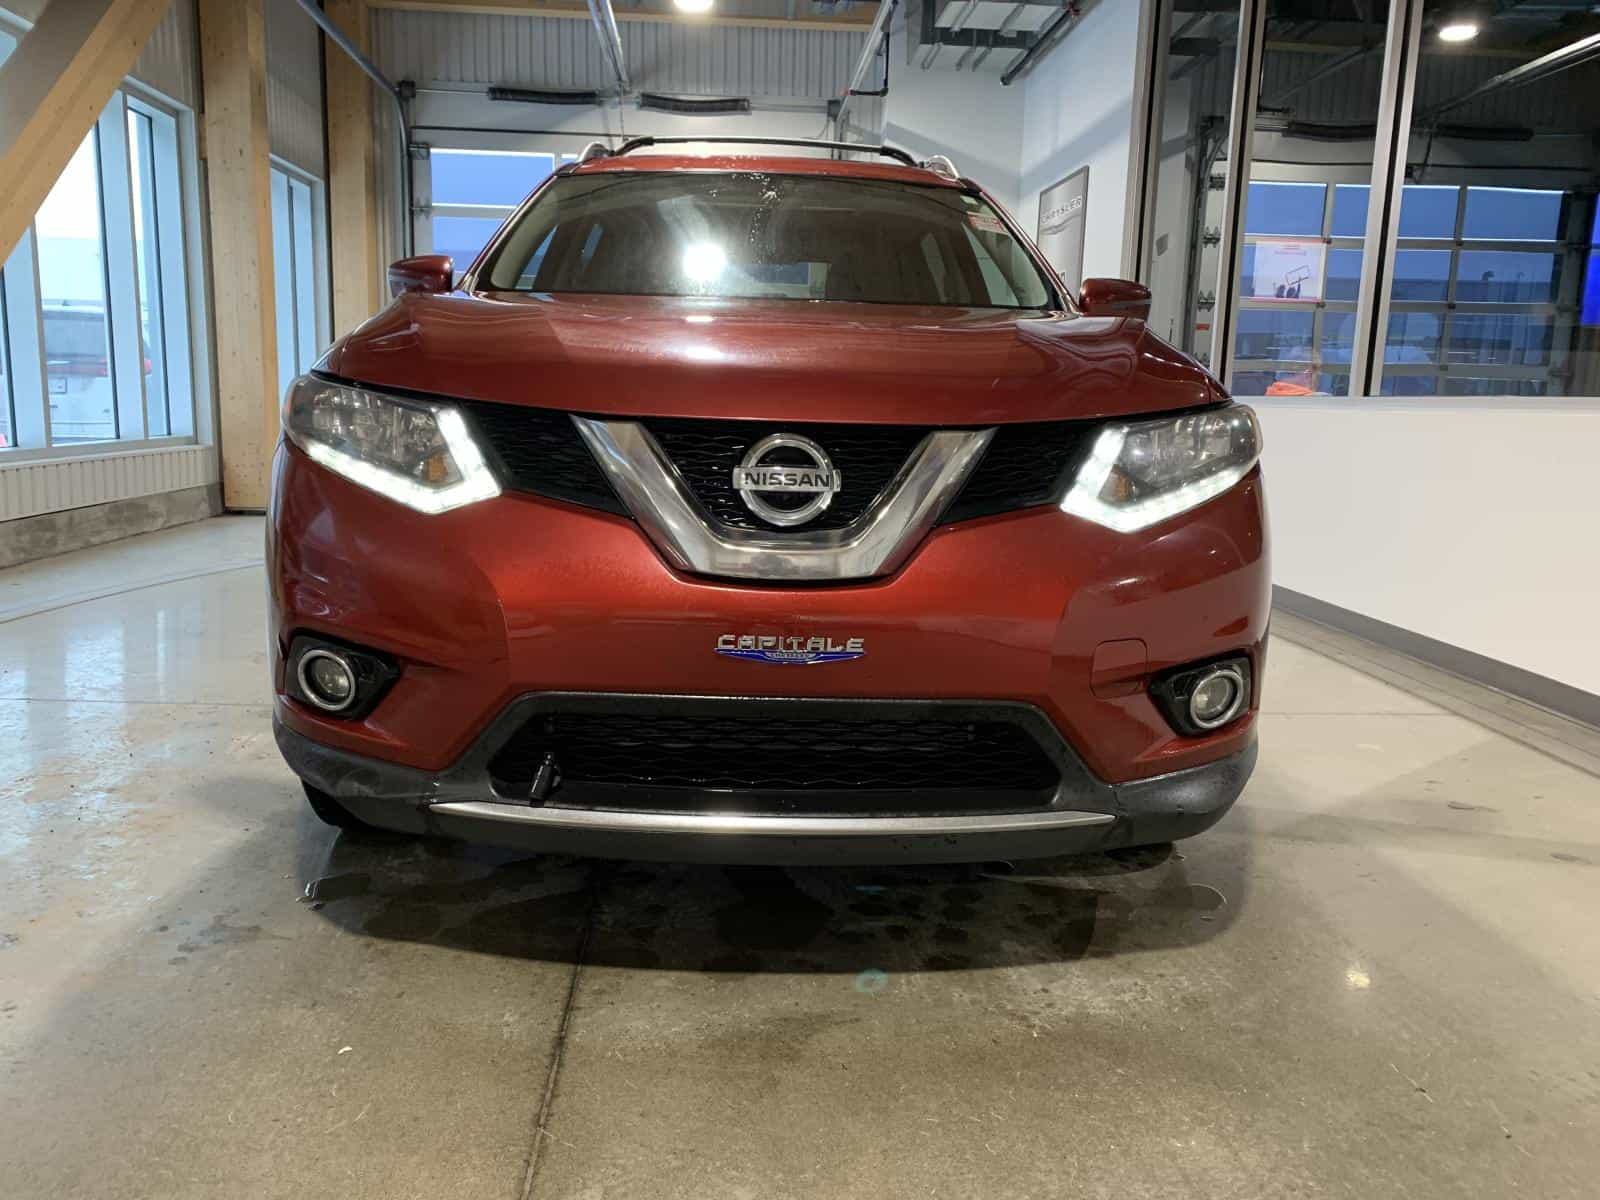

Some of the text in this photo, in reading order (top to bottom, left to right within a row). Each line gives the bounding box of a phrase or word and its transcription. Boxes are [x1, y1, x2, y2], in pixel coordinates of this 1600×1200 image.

[1040, 196, 1082, 223] CHRYSLER
[744, 472, 830, 488] NISSAN
[717, 634, 865, 652] CAPITALE
